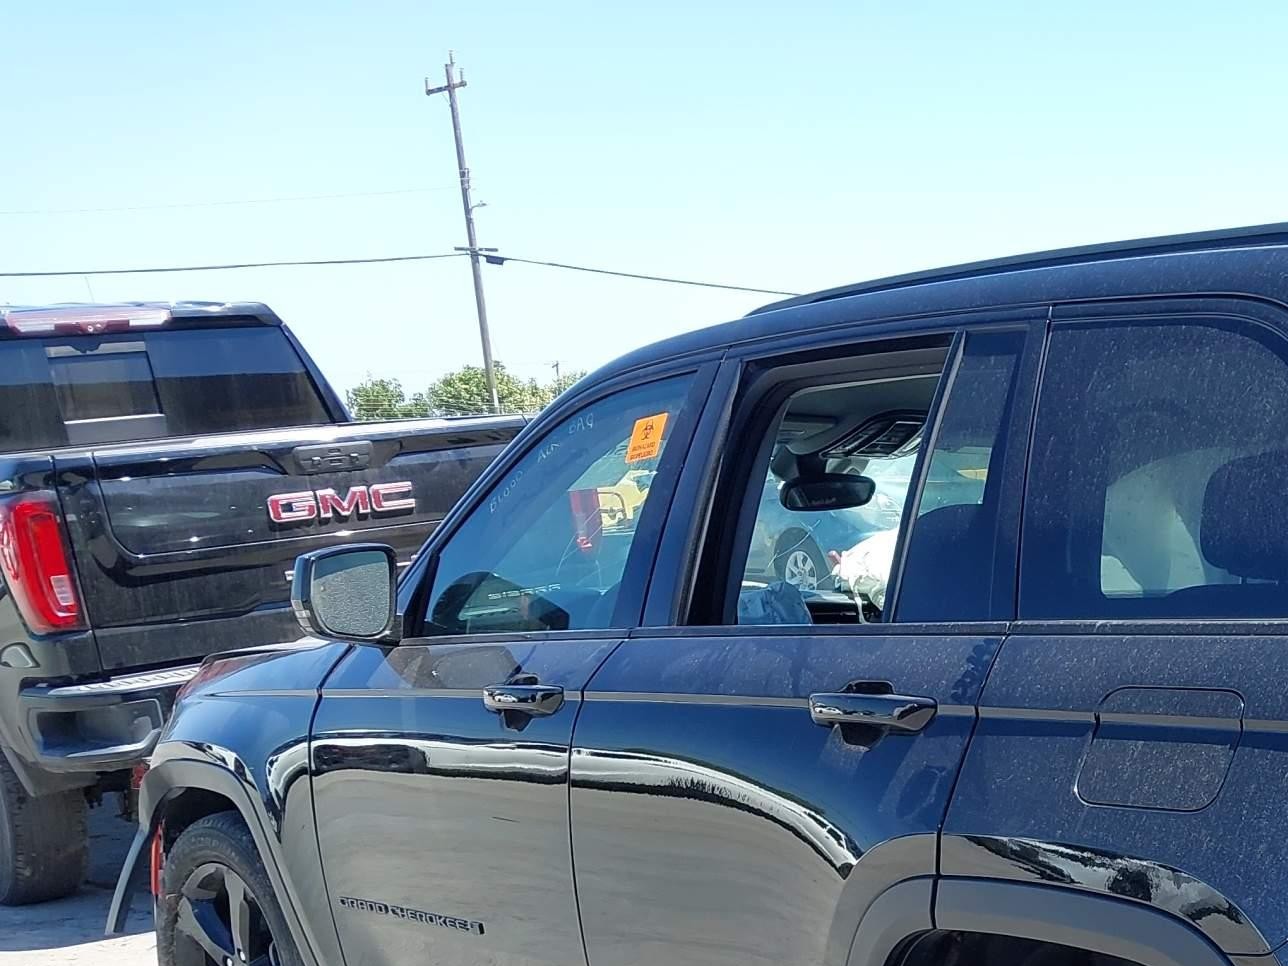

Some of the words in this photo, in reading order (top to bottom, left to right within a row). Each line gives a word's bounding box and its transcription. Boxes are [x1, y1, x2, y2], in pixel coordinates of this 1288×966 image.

[267, 481, 416, 523] GMC
[339, 896, 389, 914] GRAND
[390, 905, 470, 931] CHEROKEE
